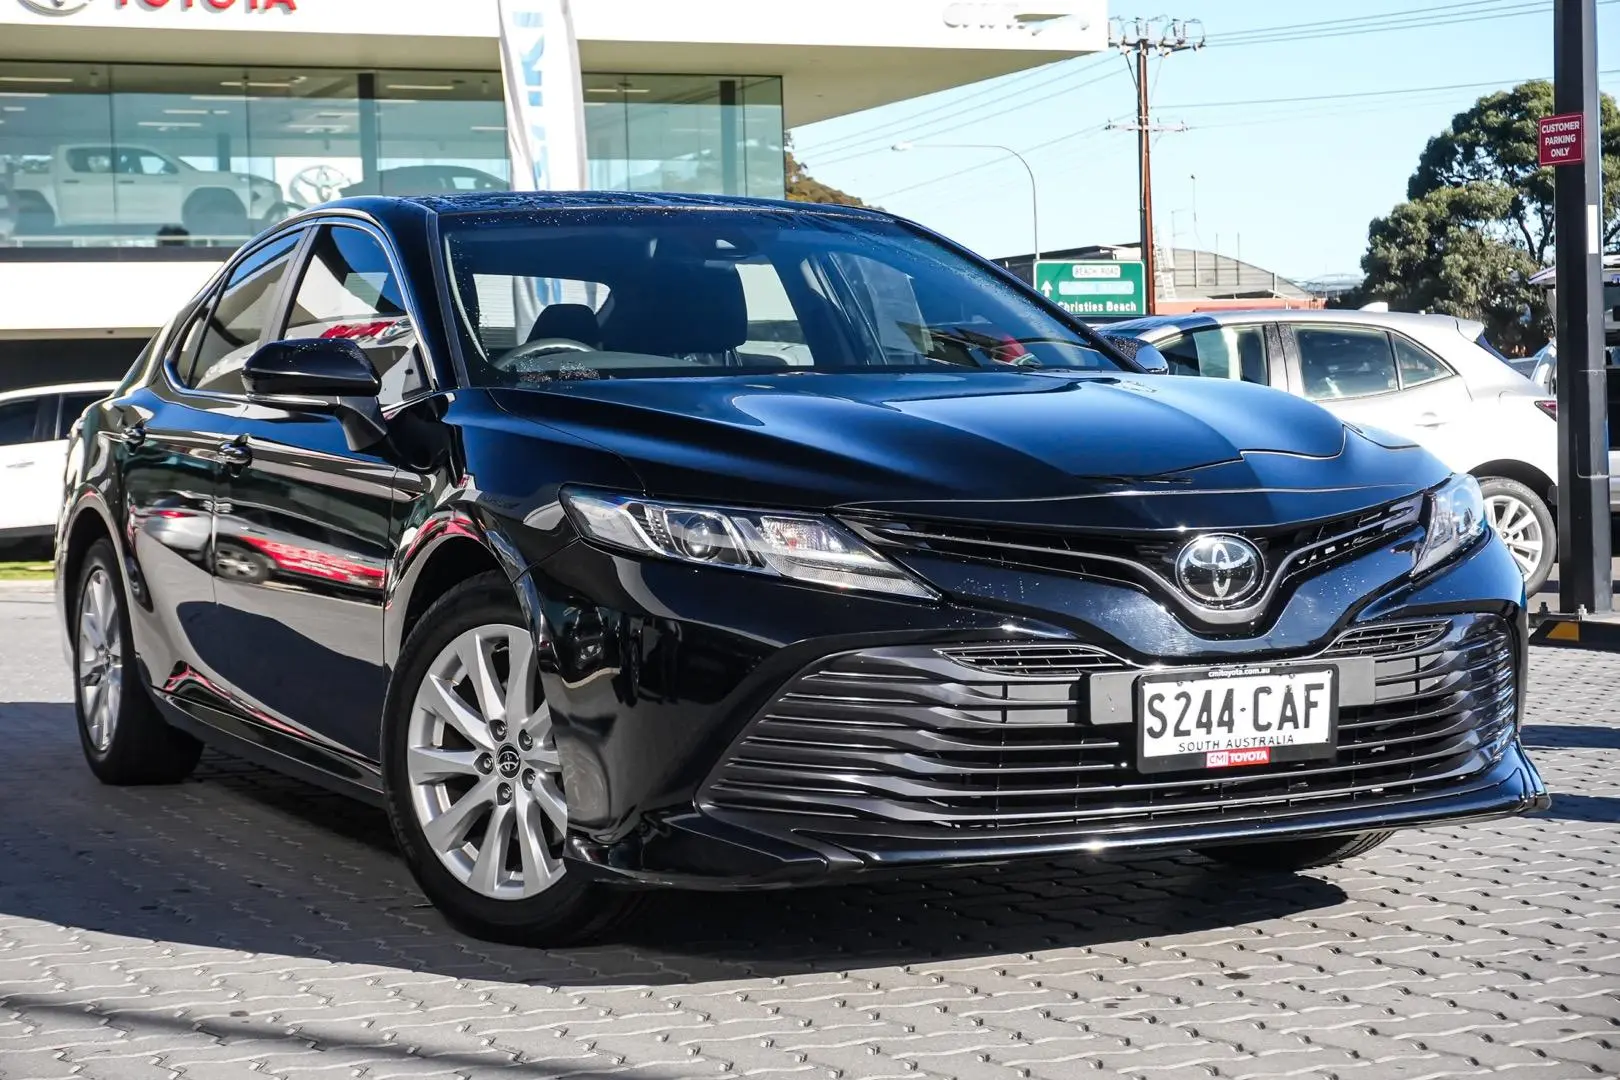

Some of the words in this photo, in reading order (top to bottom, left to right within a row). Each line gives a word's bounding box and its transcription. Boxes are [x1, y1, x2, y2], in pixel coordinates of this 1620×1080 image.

[1541, 121, 1580, 134] CUSTOMER
[1544, 134, 1576, 146] PARKING
[1550, 147, 1570, 158] ONLY
[1106, 301, 1137, 312] Beach
[1208, 667, 1271, 678] cmitoyota.com.au
[1178, 739, 1220, 753] SOUTH
[1226, 734, 1294, 749] AUSTRALIA
[1209, 753, 1227, 764] CMI
[1228, 750, 1268, 763] TOYOTA
